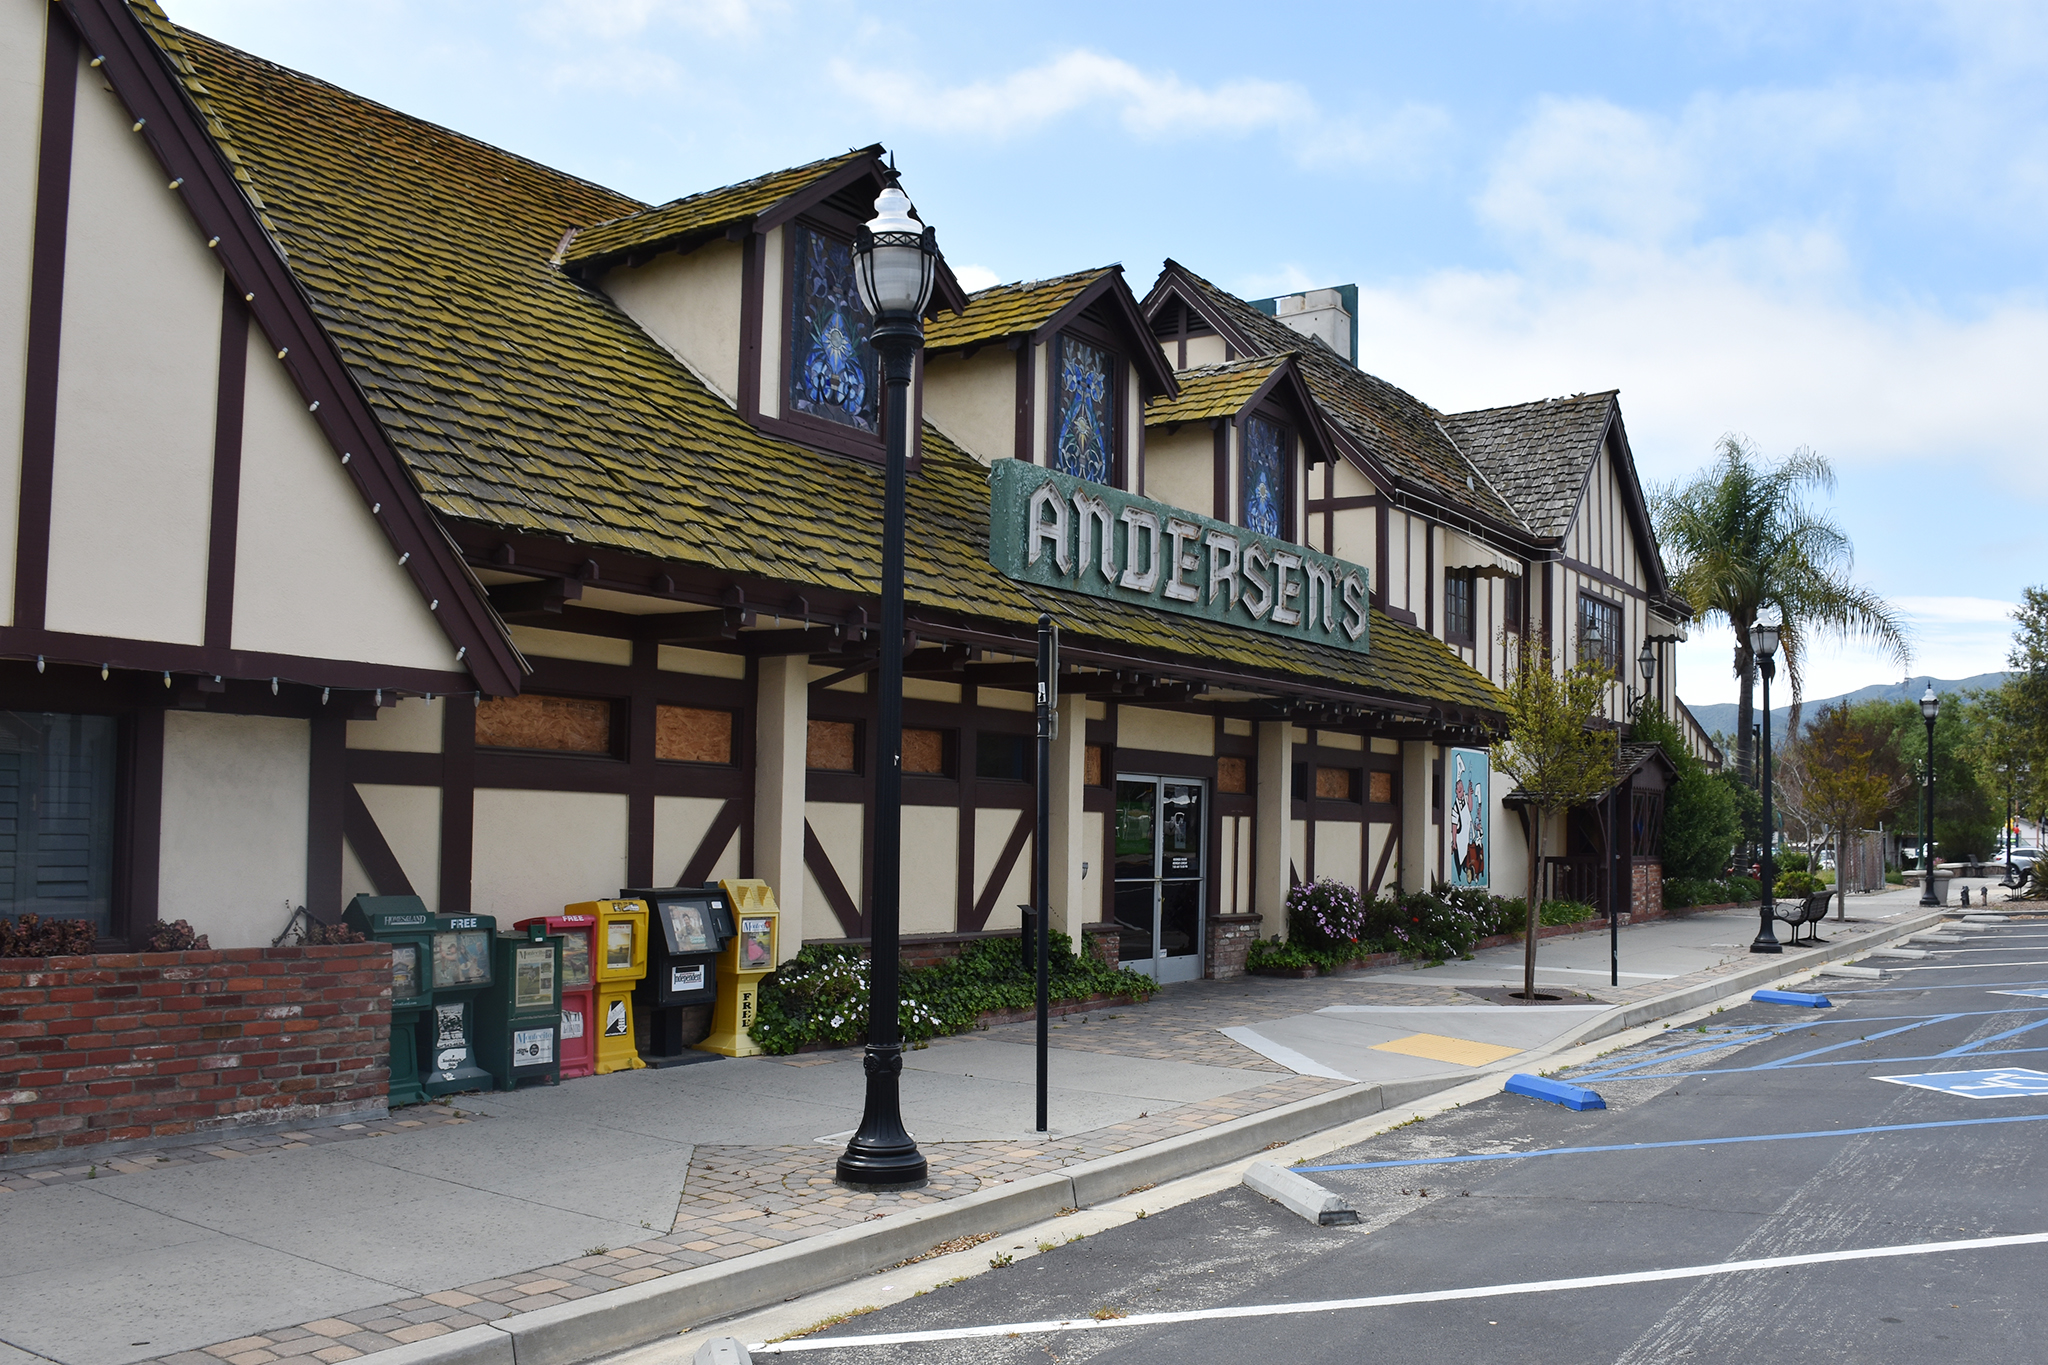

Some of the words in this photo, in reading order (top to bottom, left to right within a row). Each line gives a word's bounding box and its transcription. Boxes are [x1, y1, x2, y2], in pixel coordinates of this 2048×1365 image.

[1026, 476, 1367, 642] ANDERSEN'S
[450, 918, 477, 929] FREE
[673, 971, 702, 985] Independent
[742, 992, 752, 1028] FREE
[516, 1031, 553, 1044] Montecito
